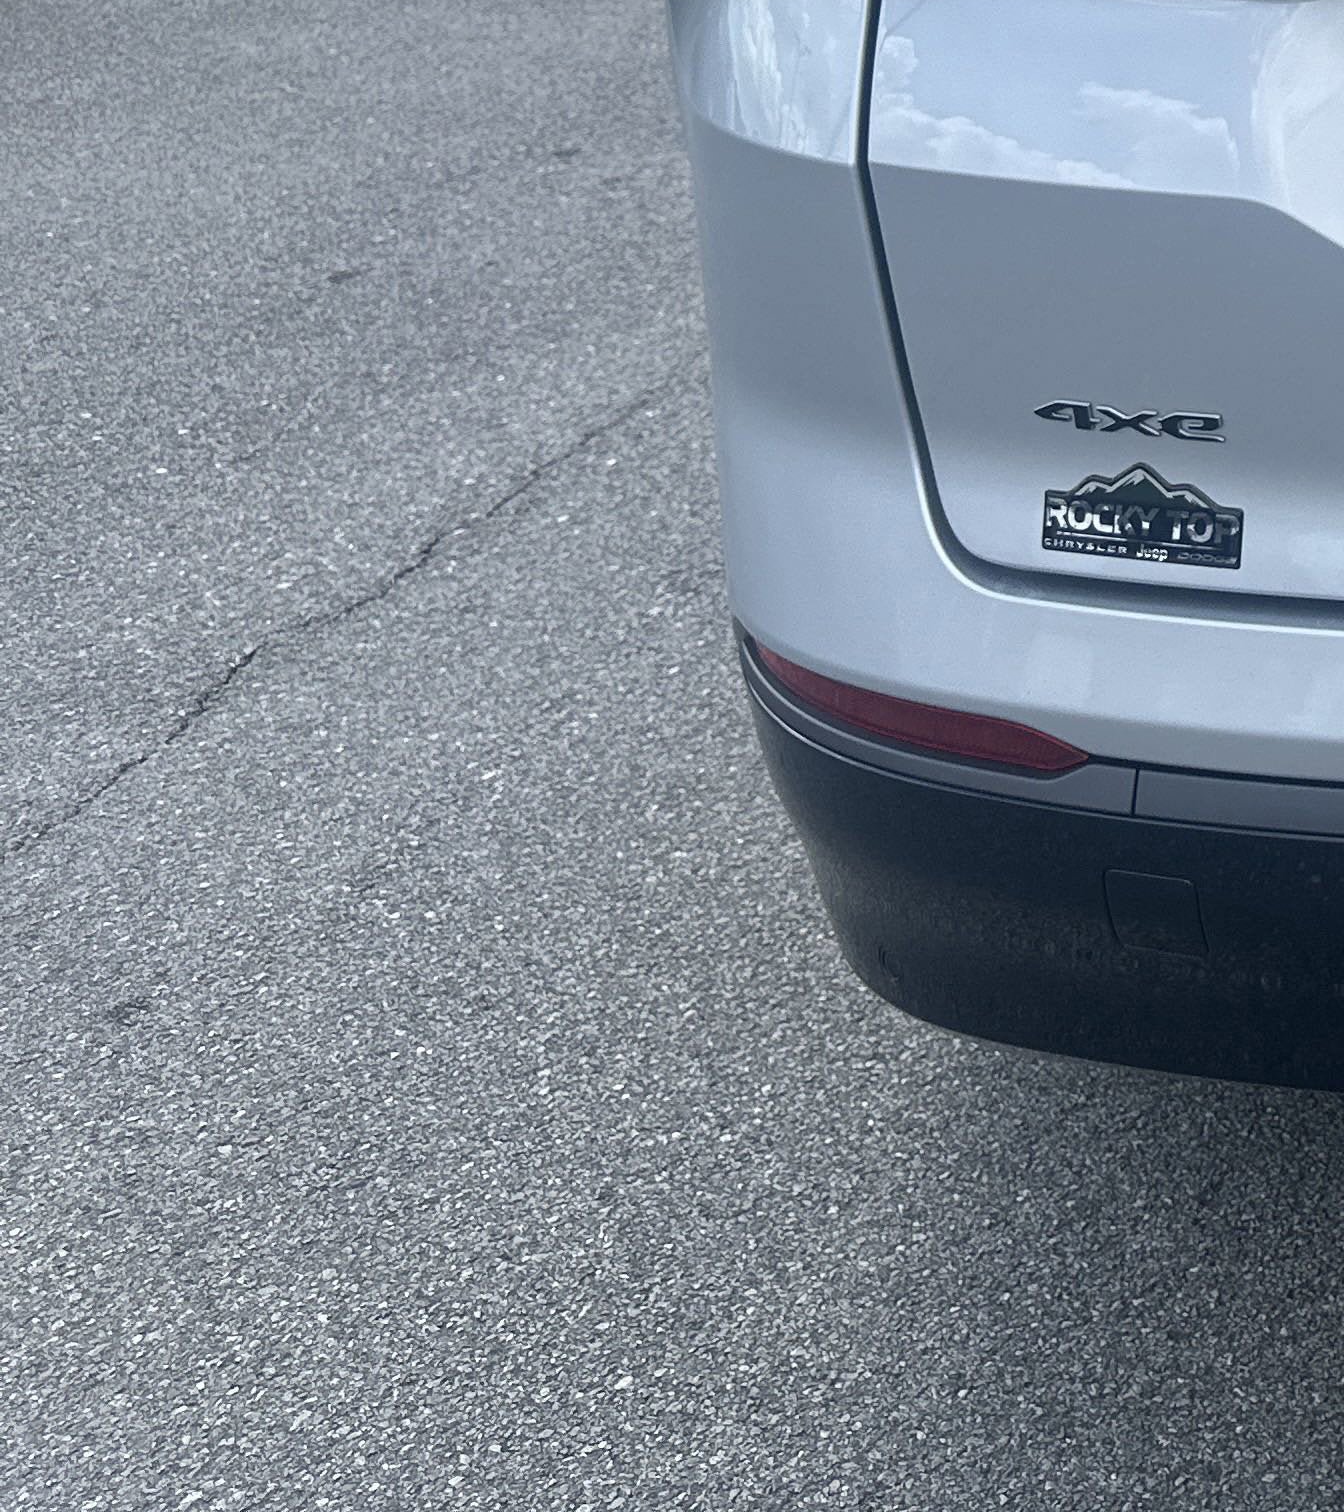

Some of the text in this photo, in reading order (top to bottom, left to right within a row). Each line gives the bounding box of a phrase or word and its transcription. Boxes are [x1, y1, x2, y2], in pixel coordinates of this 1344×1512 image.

[1034, 399, 1226, 443] 4xe
[1045, 496, 1241, 545] ROCKY TOP
[1043, 538, 1128, 555] CHRYSLER
[1136, 543, 1169, 562] Jeep
